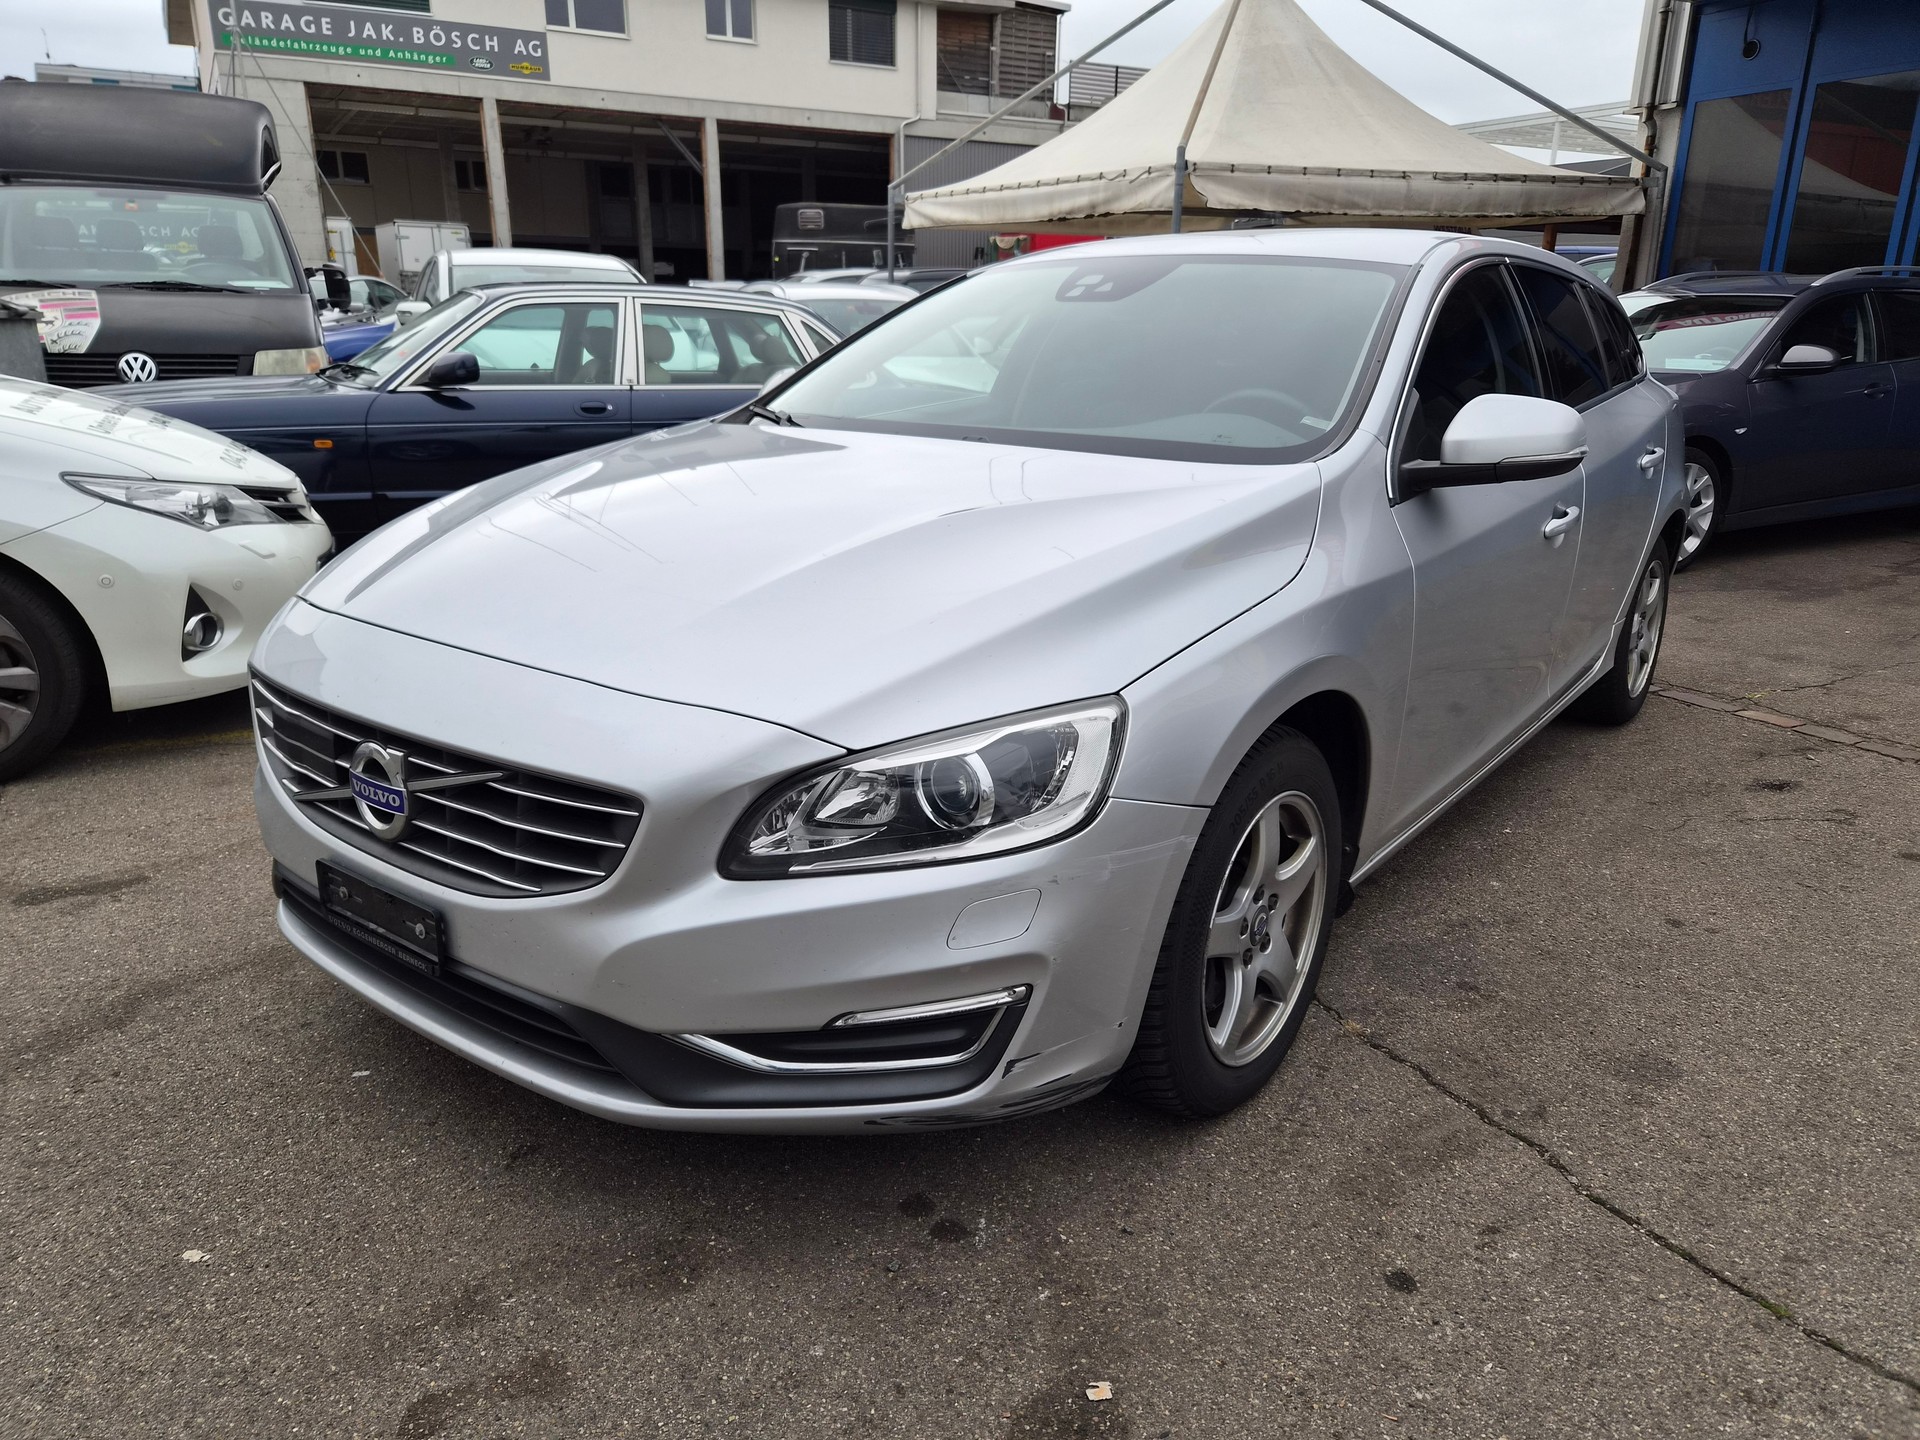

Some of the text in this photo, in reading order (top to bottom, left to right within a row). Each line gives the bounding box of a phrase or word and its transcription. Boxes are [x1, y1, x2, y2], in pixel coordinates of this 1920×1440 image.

[217, 7, 543, 58] GARAGE JAK. BÖSCH AG
[359, 47, 382, 58] und
[388, 49, 448, 65] Anhänger
[351, 777, 401, 808] VOLVO
[328, 915, 352, 934] VOLVO
[352, 927, 397, 957] EGGENBERGER
